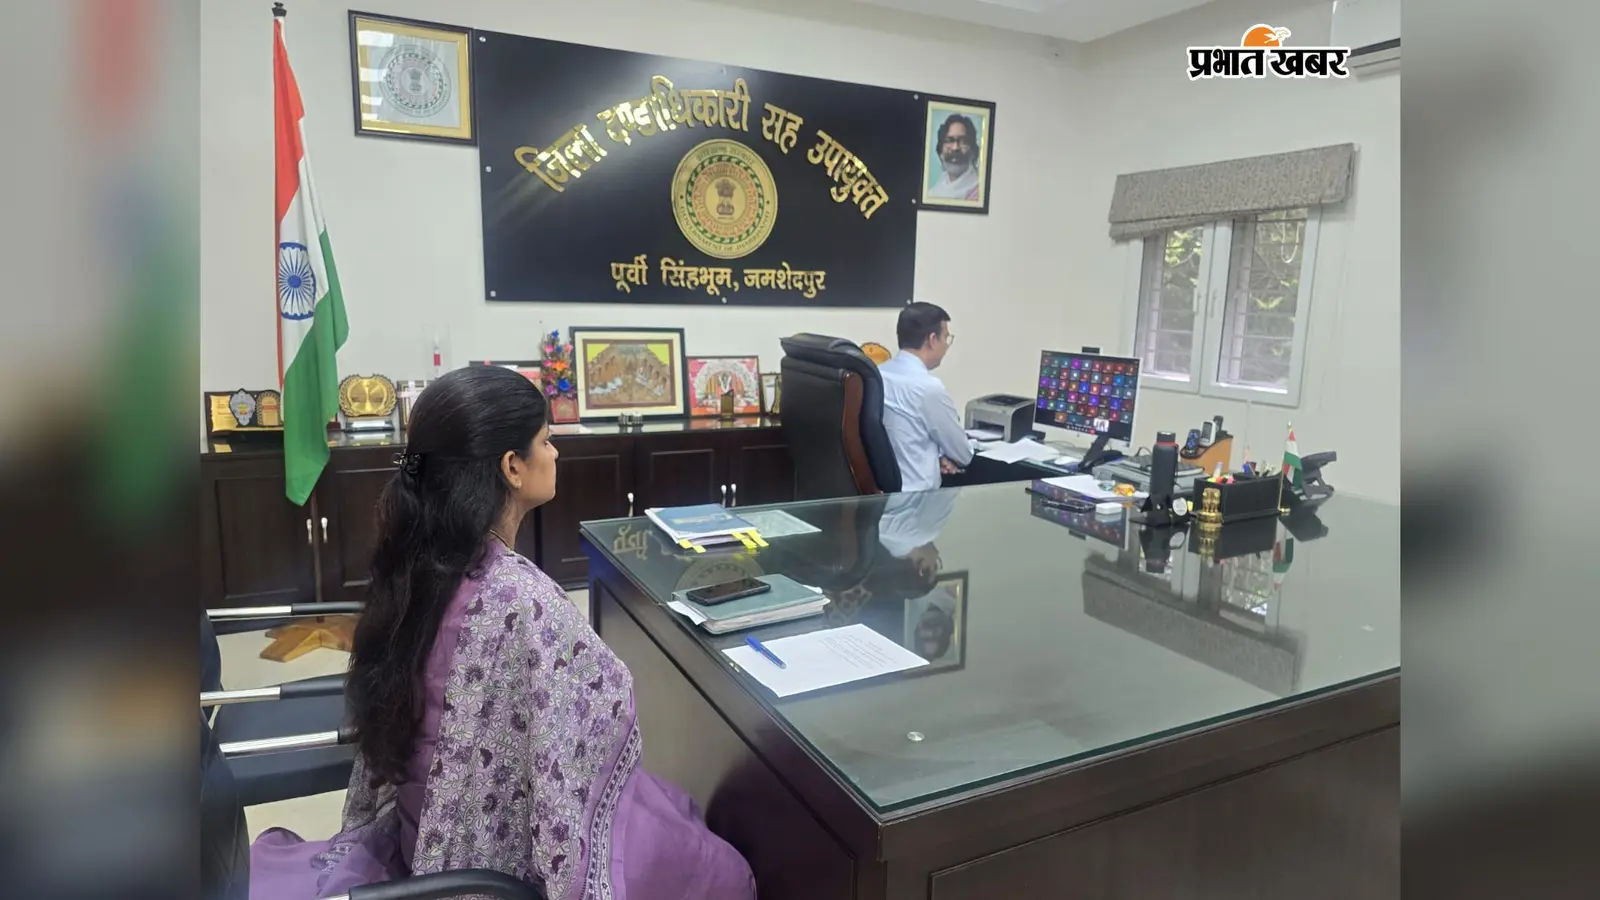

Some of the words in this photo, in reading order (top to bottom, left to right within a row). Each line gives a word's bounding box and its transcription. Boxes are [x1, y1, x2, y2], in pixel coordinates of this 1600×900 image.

[514, 123, 607, 193] जिला
[597, 75, 751, 146] दण्डाधिकारी
[762, 102, 804, 154] सह
[807, 129, 889, 219] उपायुक्त
[611, 254, 648, 294] पूर्वी
[660, 257, 739, 296] सिंहभूम,
[743, 261, 826, 298] जमशेदपुर
